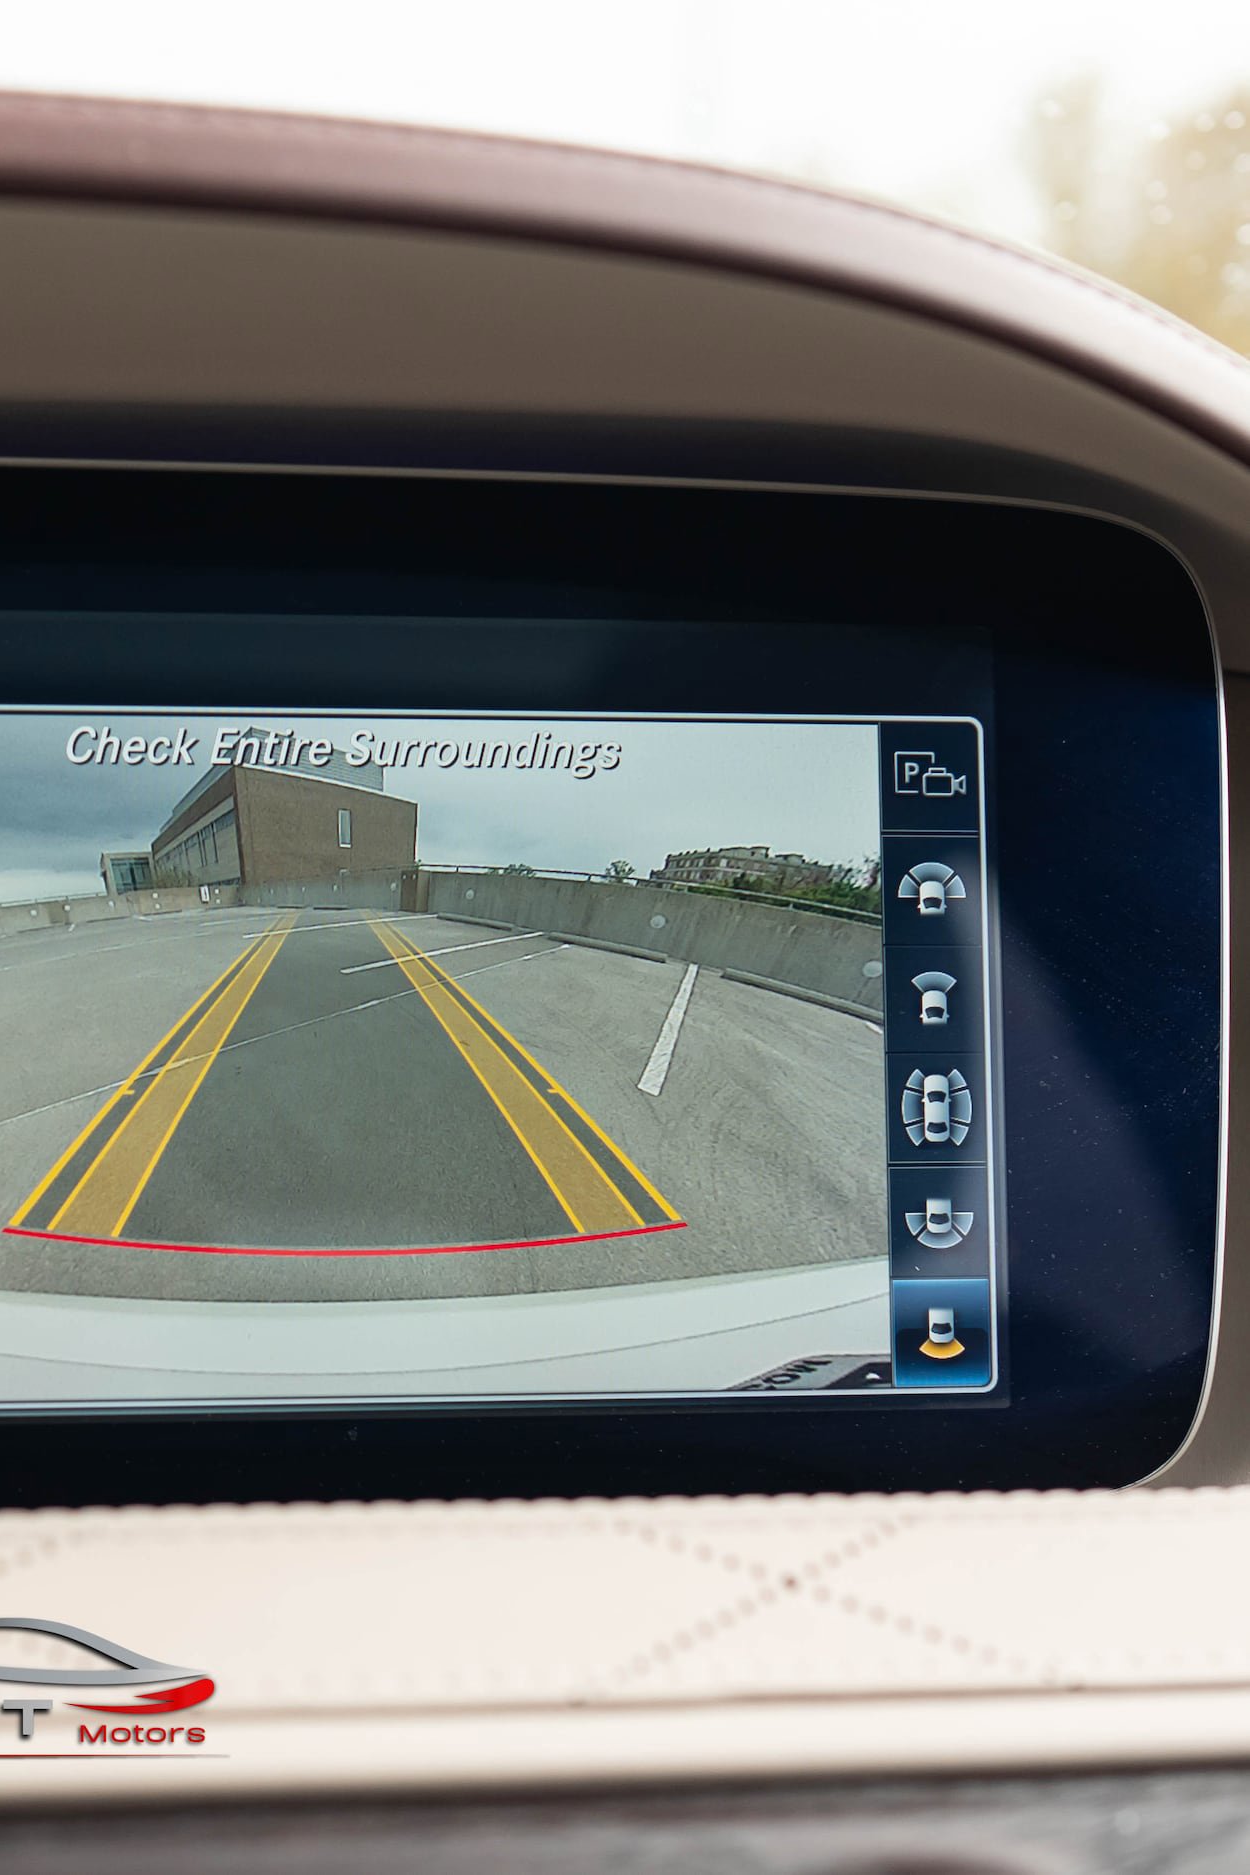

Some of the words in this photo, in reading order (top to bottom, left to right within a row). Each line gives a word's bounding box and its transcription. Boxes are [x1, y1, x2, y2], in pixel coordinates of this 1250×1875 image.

[65, 725, 199, 767] Check
[210, 727, 333, 768] Entire
[345, 729, 623, 779] Surroundings
[904, 761, 920, 784] P
